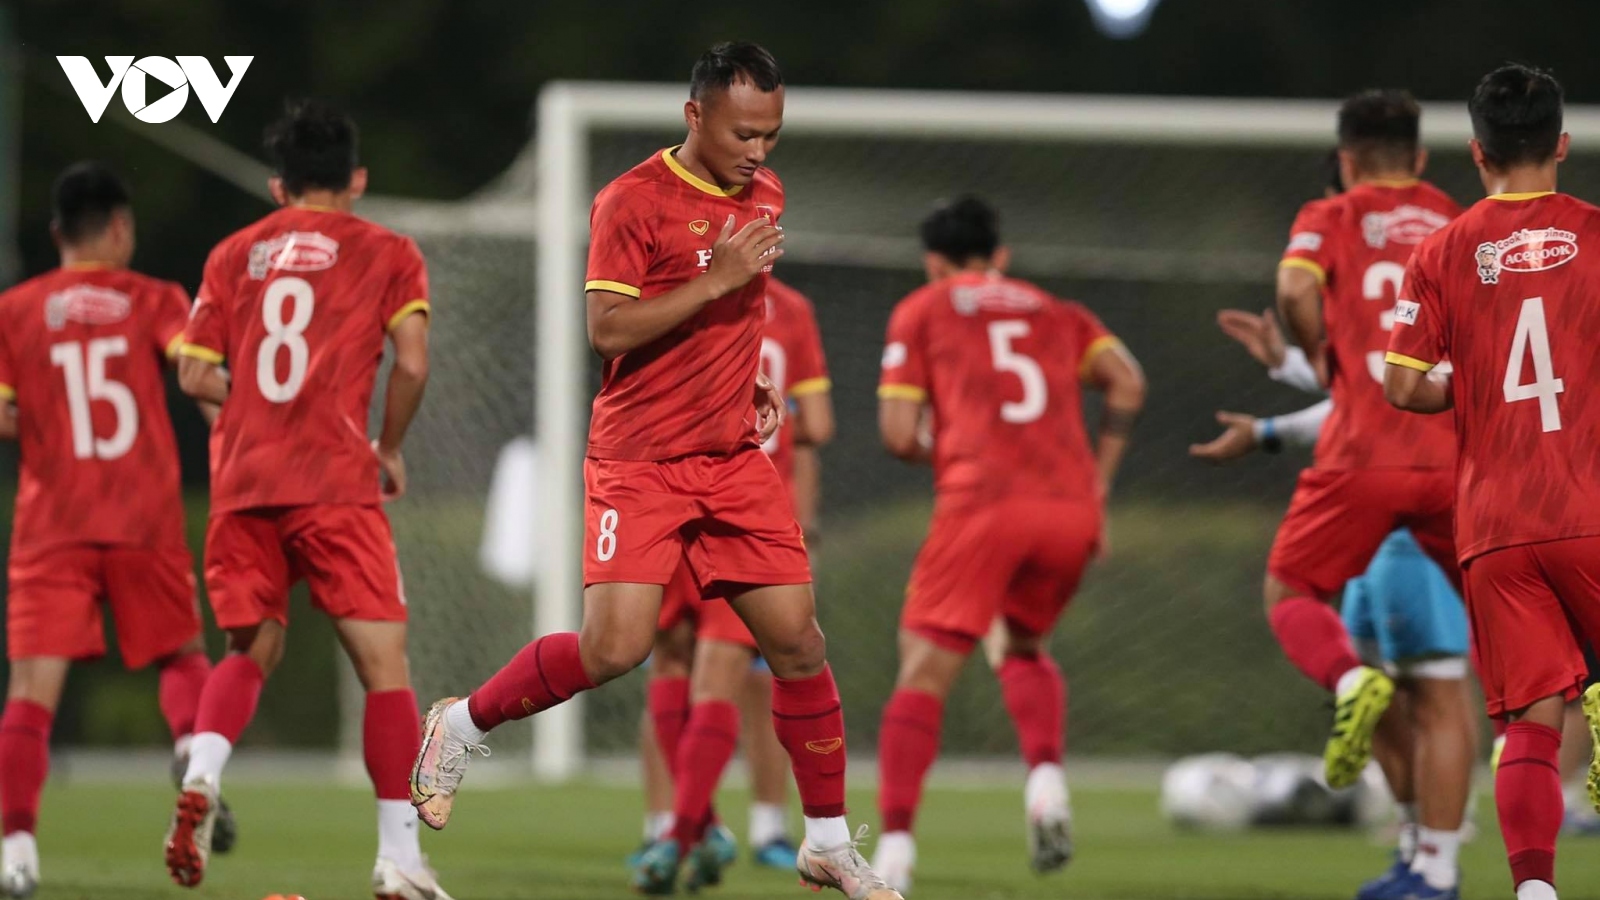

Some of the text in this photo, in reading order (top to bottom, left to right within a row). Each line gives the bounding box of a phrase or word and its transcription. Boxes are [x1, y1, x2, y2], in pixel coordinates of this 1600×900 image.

[1497, 234, 1522, 251] Cook
[257, 275, 314, 402] 8
[988, 320, 1048, 423] 5
[1503, 297, 1563, 432] 4
[51, 337, 138, 459] 15
[597, 509, 618, 561] 8
